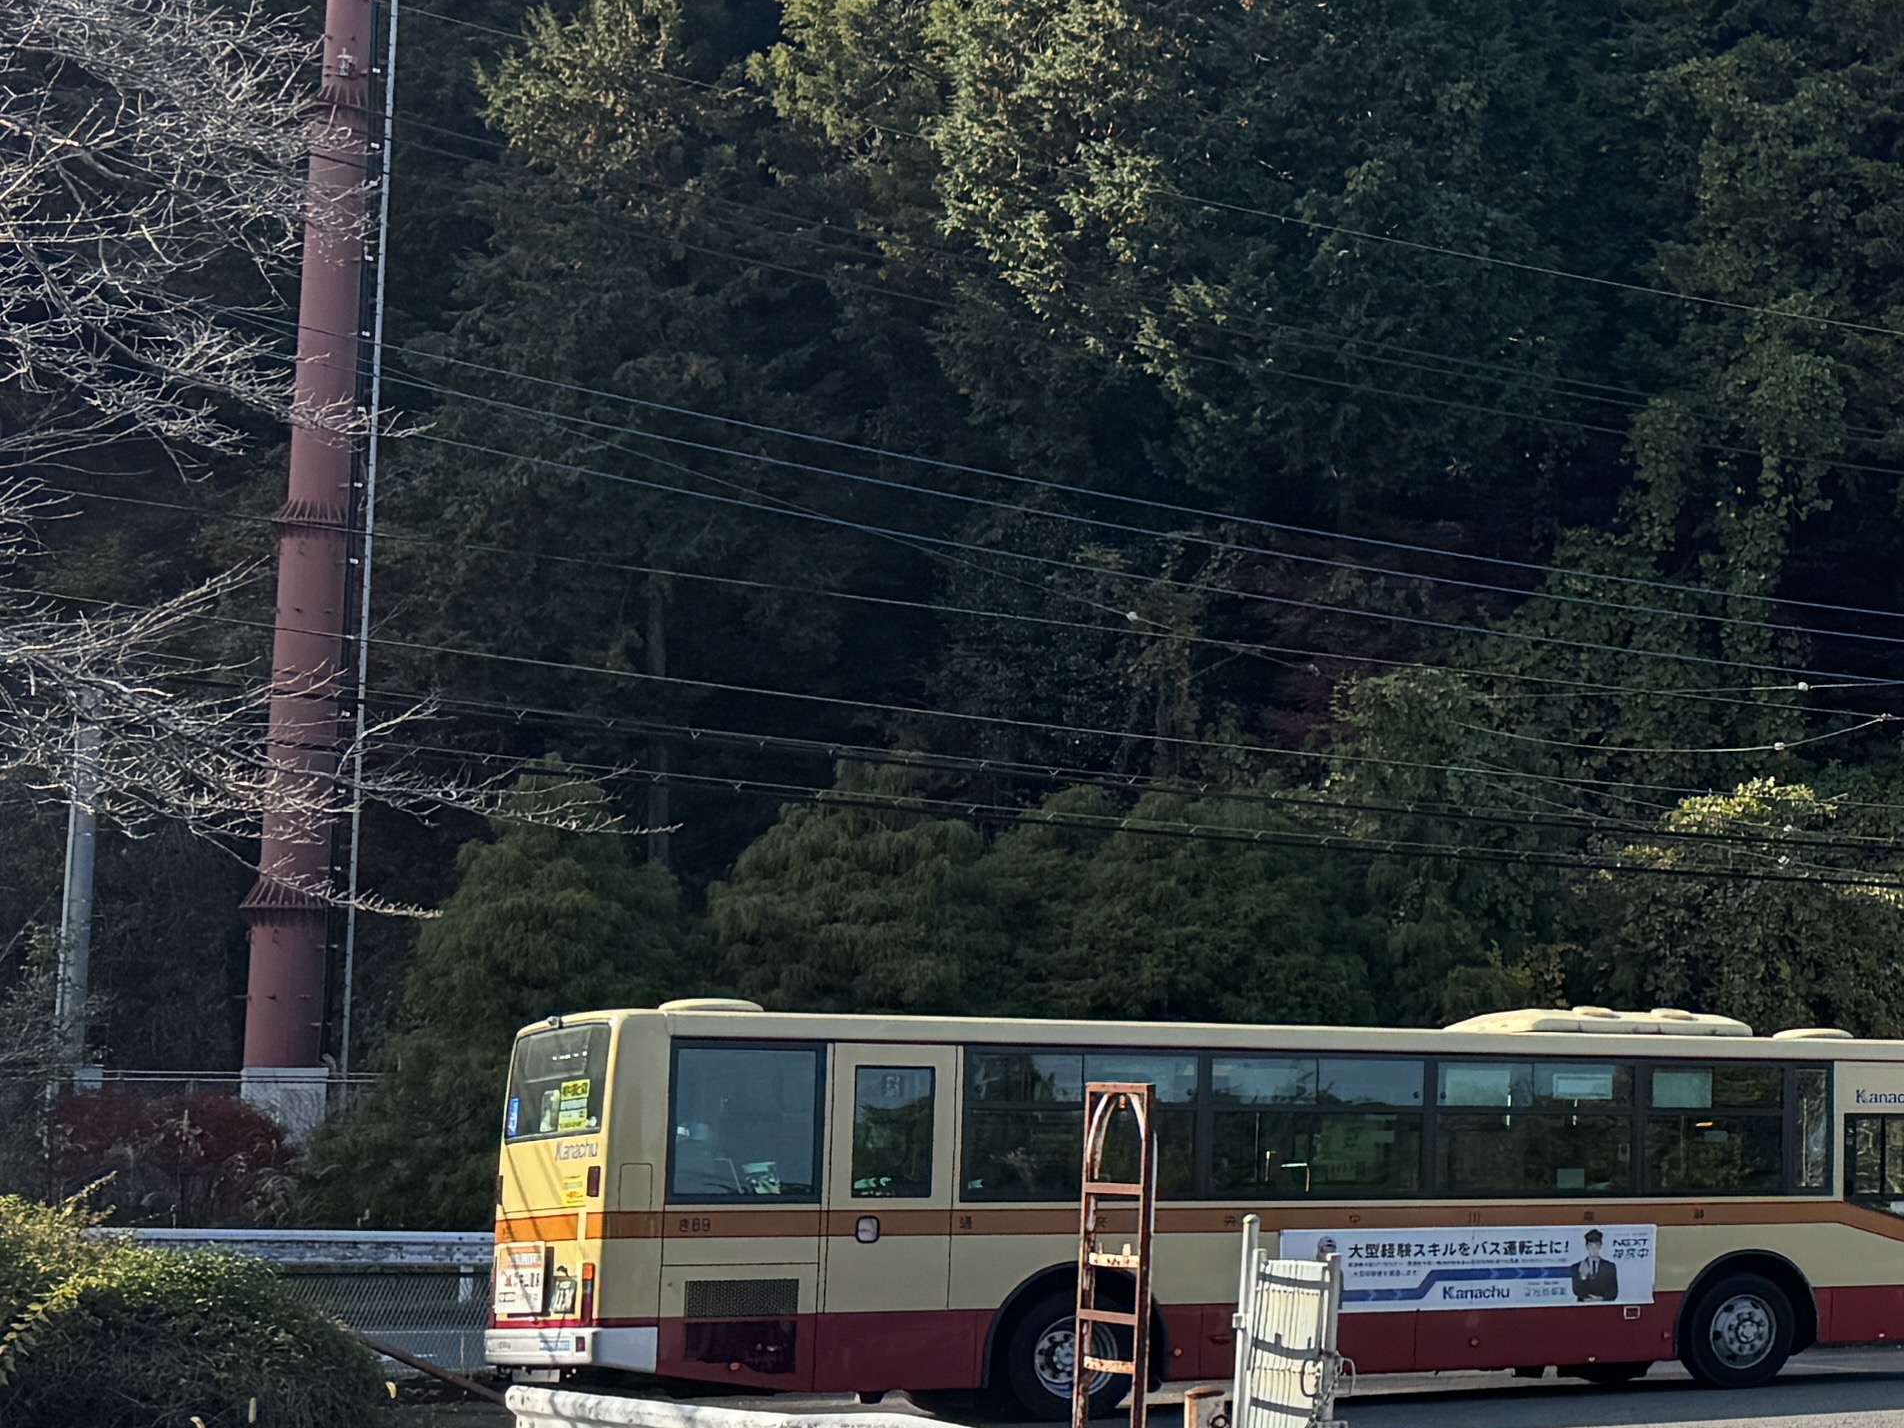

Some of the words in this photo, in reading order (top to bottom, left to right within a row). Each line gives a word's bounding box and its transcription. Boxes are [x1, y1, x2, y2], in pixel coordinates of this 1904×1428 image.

[555, 1138, 598, 1161] Kanachu
[1612, 1238, 1649, 1247] NEXT
[1442, 1285, 1510, 1300] Kanachu
